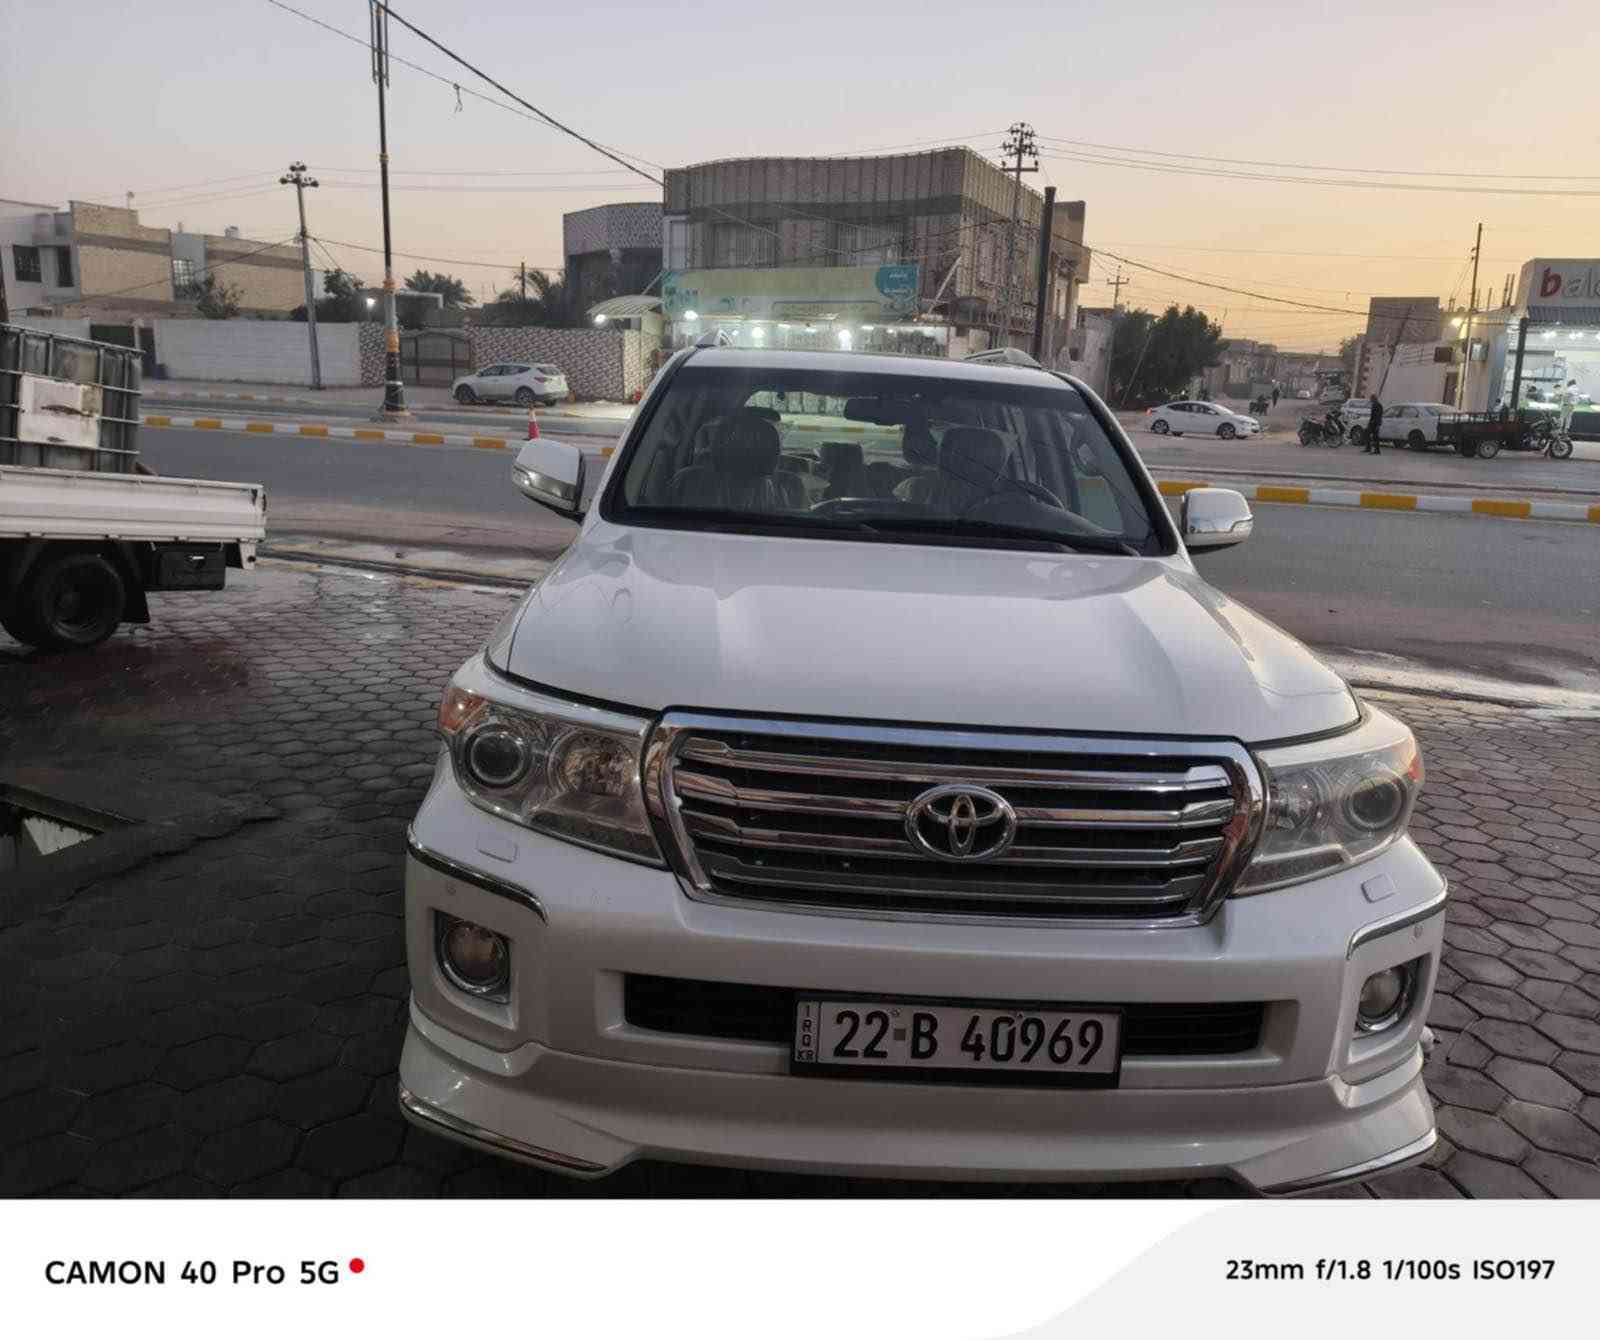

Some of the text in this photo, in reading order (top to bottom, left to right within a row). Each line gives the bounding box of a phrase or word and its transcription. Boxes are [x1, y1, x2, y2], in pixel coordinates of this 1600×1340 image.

[833, 1010, 1104, 1066] 22 B 40969
